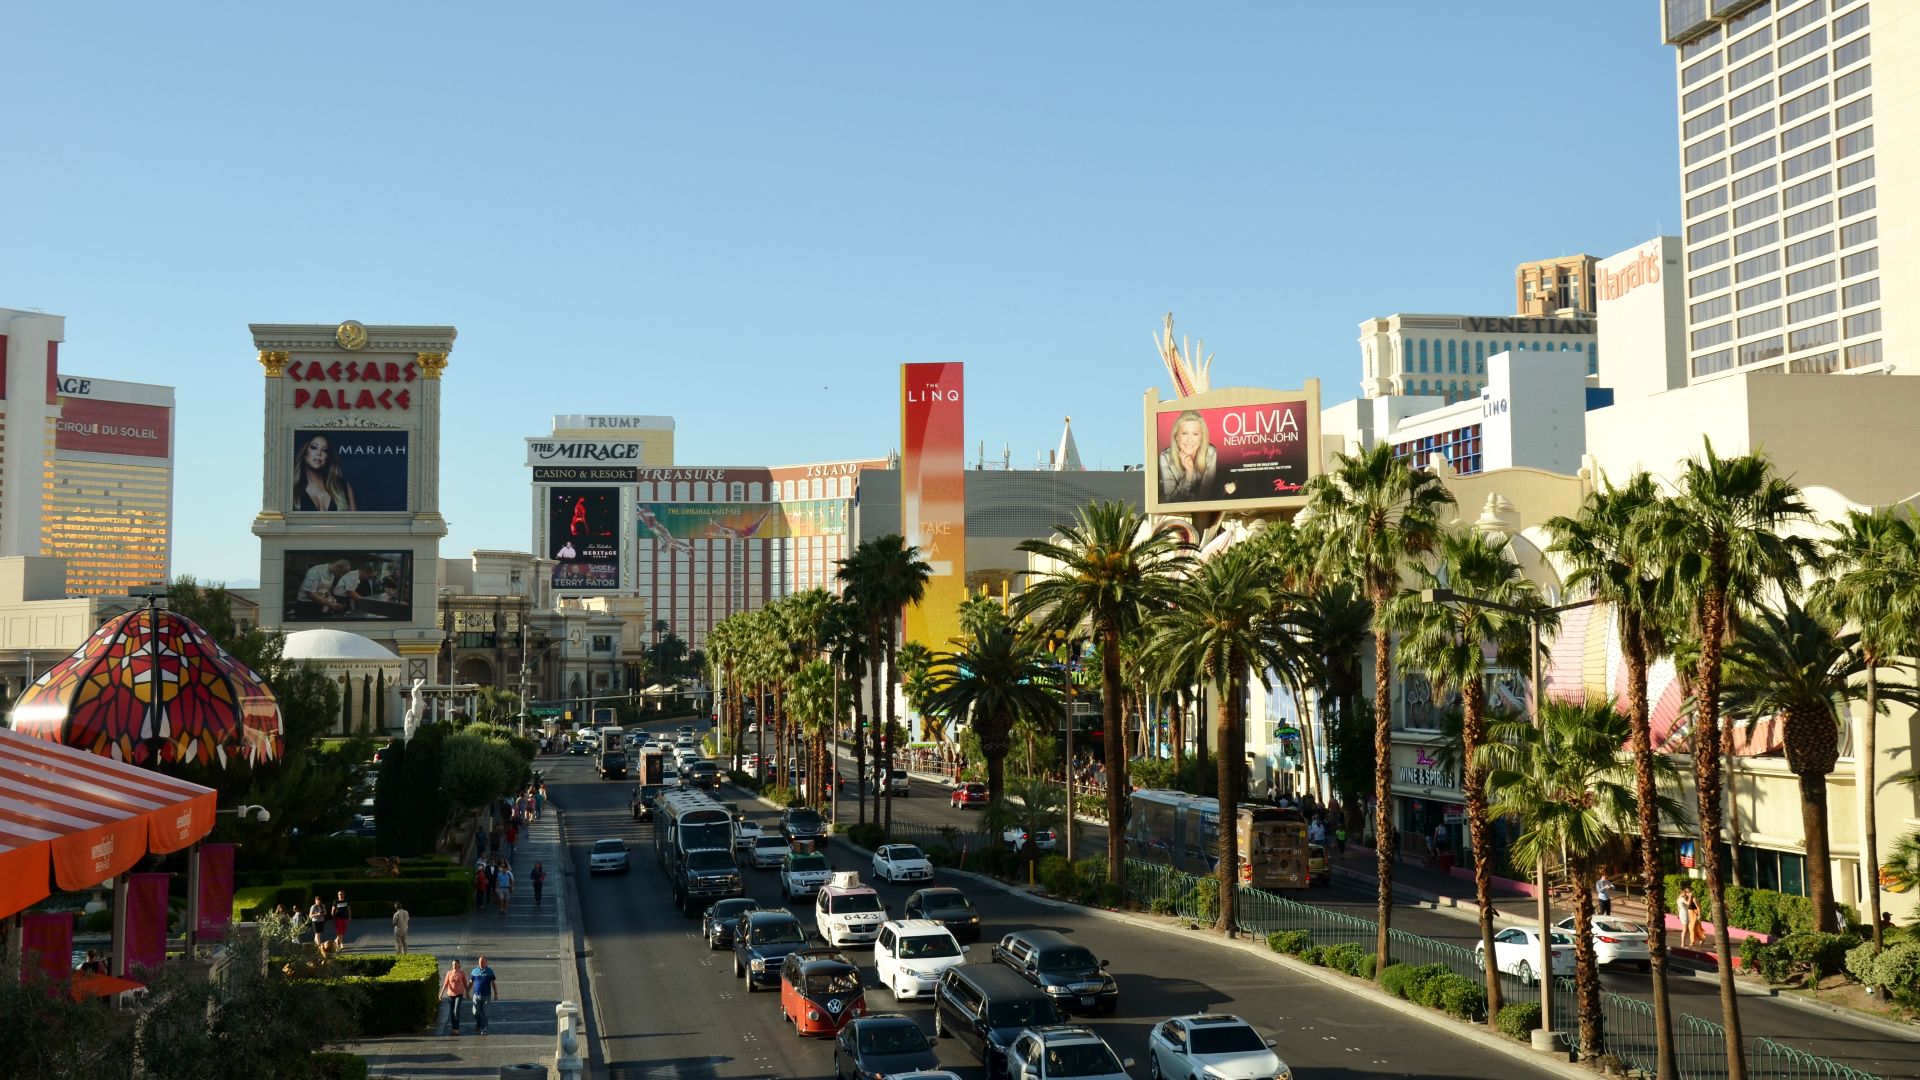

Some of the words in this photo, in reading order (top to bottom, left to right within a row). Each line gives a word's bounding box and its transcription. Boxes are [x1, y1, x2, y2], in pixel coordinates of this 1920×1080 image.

[1469, 317, 1591, 334] VENETIAN
[287, 360, 417, 383] CAESARS
[295, 388, 411, 410] PALACE
[908, 389, 959, 402] LINQ
[1483, 398, 1507, 419] LINQ
[587, 417, 641, 428] TRUMP
[1222, 408, 1299, 437] OLIVIA
[102, 425, 118, 436] DU
[120, 427, 158, 439] SOLEIL
[1223, 431, 1299, 446] NEWTON-JOHN
[338, 445, 406, 455] MARIAH
[531, 443, 555, 453] THE
[540, 443, 639, 460] MIRAGE
[535, 469, 576, 479] CASINO
[590, 470, 635, 479] RESORT
[640, 469, 725, 481] TREASURE
[807, 463, 857, 478] ISLAND
[919, 521, 951, 535] TAKE
[930, 541, 940, 554] A
[555, 579, 584, 587] TERRY
[586, 579, 615, 587] FATOR
[1400, 766, 1418, 784] WINE
[1419, 768, 1425, 784] &
[844, 913, 879, 921] 6423
[827, 998, 842, 1014] VW
